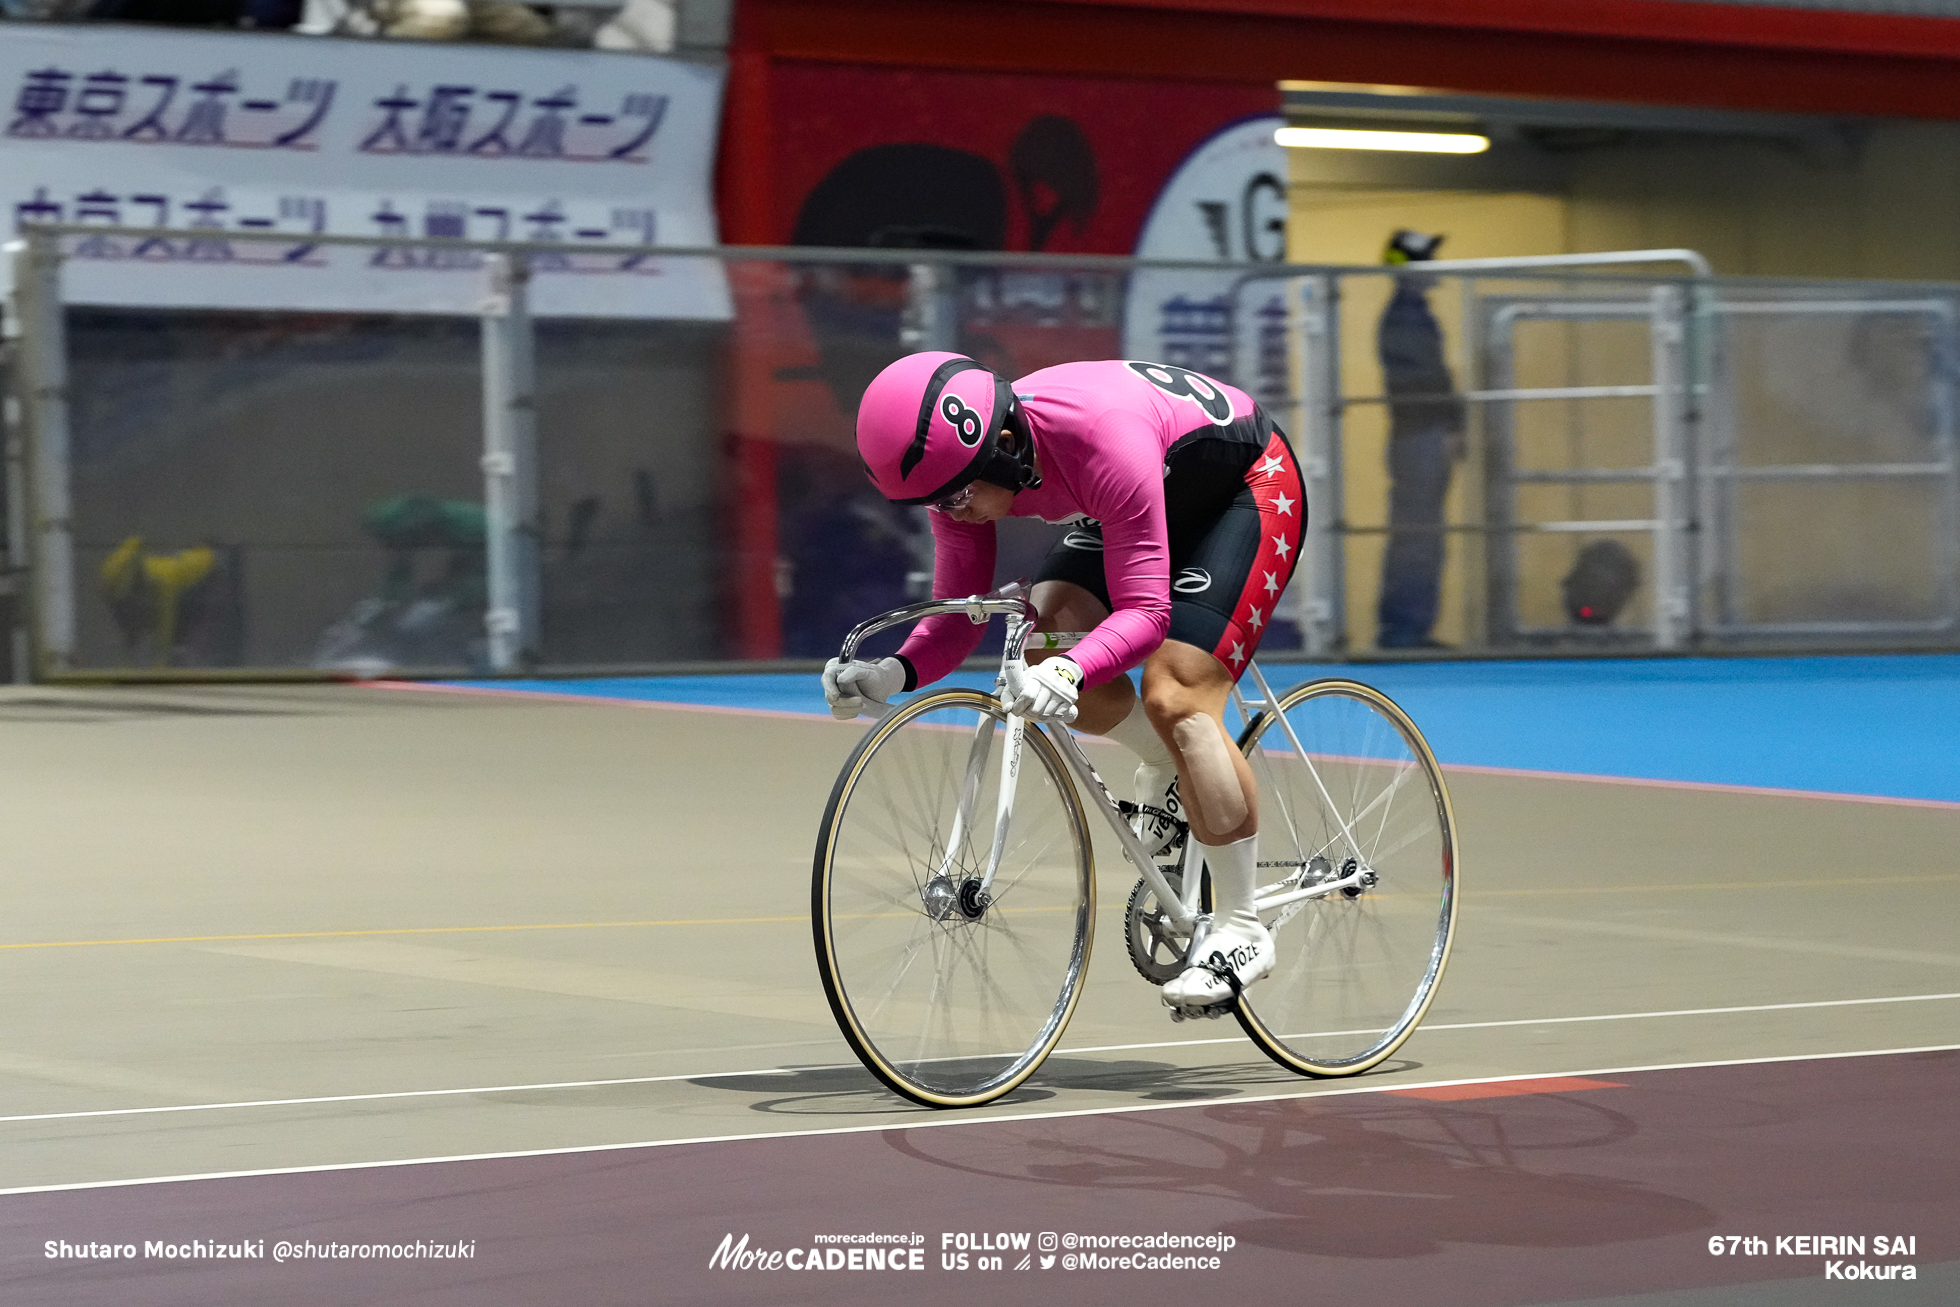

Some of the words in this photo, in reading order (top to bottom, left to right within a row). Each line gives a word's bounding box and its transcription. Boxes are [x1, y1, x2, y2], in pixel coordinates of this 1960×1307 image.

[7, 66, 337, 147] 東京スポーツ
[357, 84, 669, 160] 大阪スポーツ
[940, 393, 983, 448] 8
[1122, 360, 1235, 426] 8
